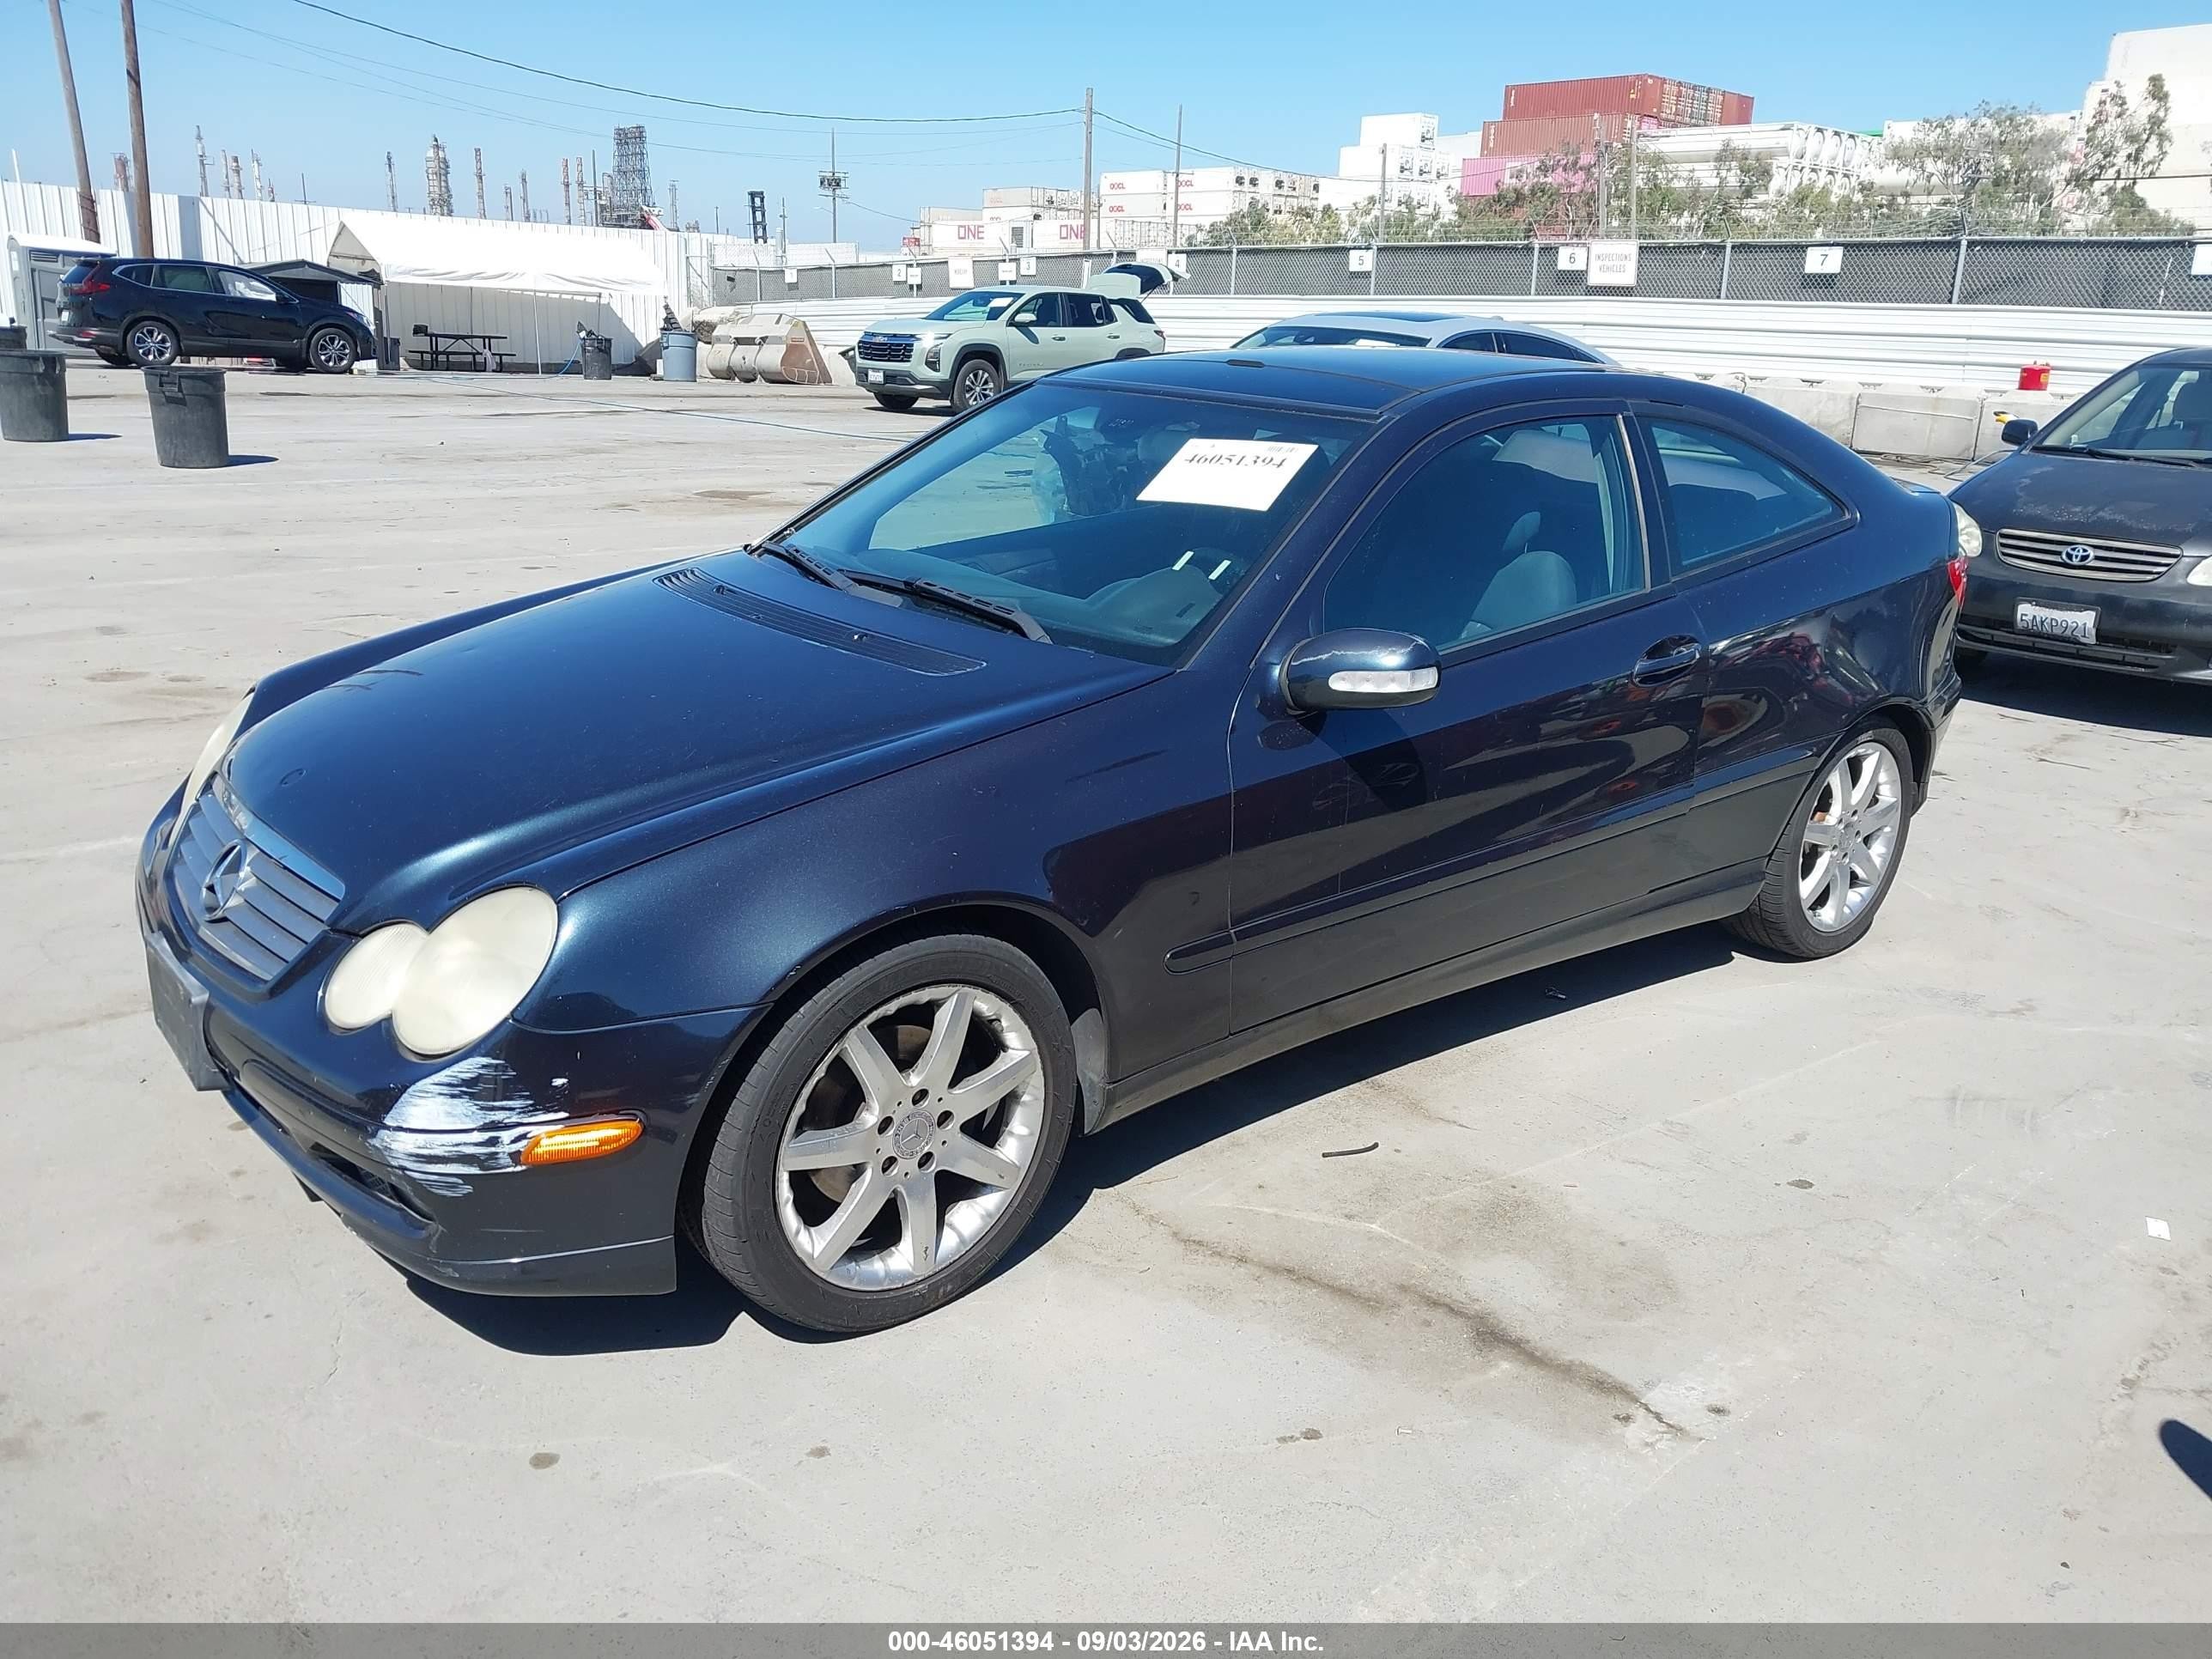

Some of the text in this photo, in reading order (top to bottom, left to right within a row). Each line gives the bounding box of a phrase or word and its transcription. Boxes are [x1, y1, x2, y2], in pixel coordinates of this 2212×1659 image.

[957, 225, 985, 240] ONE
[1358, 255, 1365, 266] 5
[1568, 252, 1577, 265] 6
[1595, 252, 1632, 262] INSPECTIONS
[1820, 253, 1829, 266] 7
[1175, 259, 1180, 269] 4
[1599, 264, 1626, 273] VEHICLES
[1185, 453, 1287, 468] 46051394
[2020, 613, 2089, 639] 5AKP921
